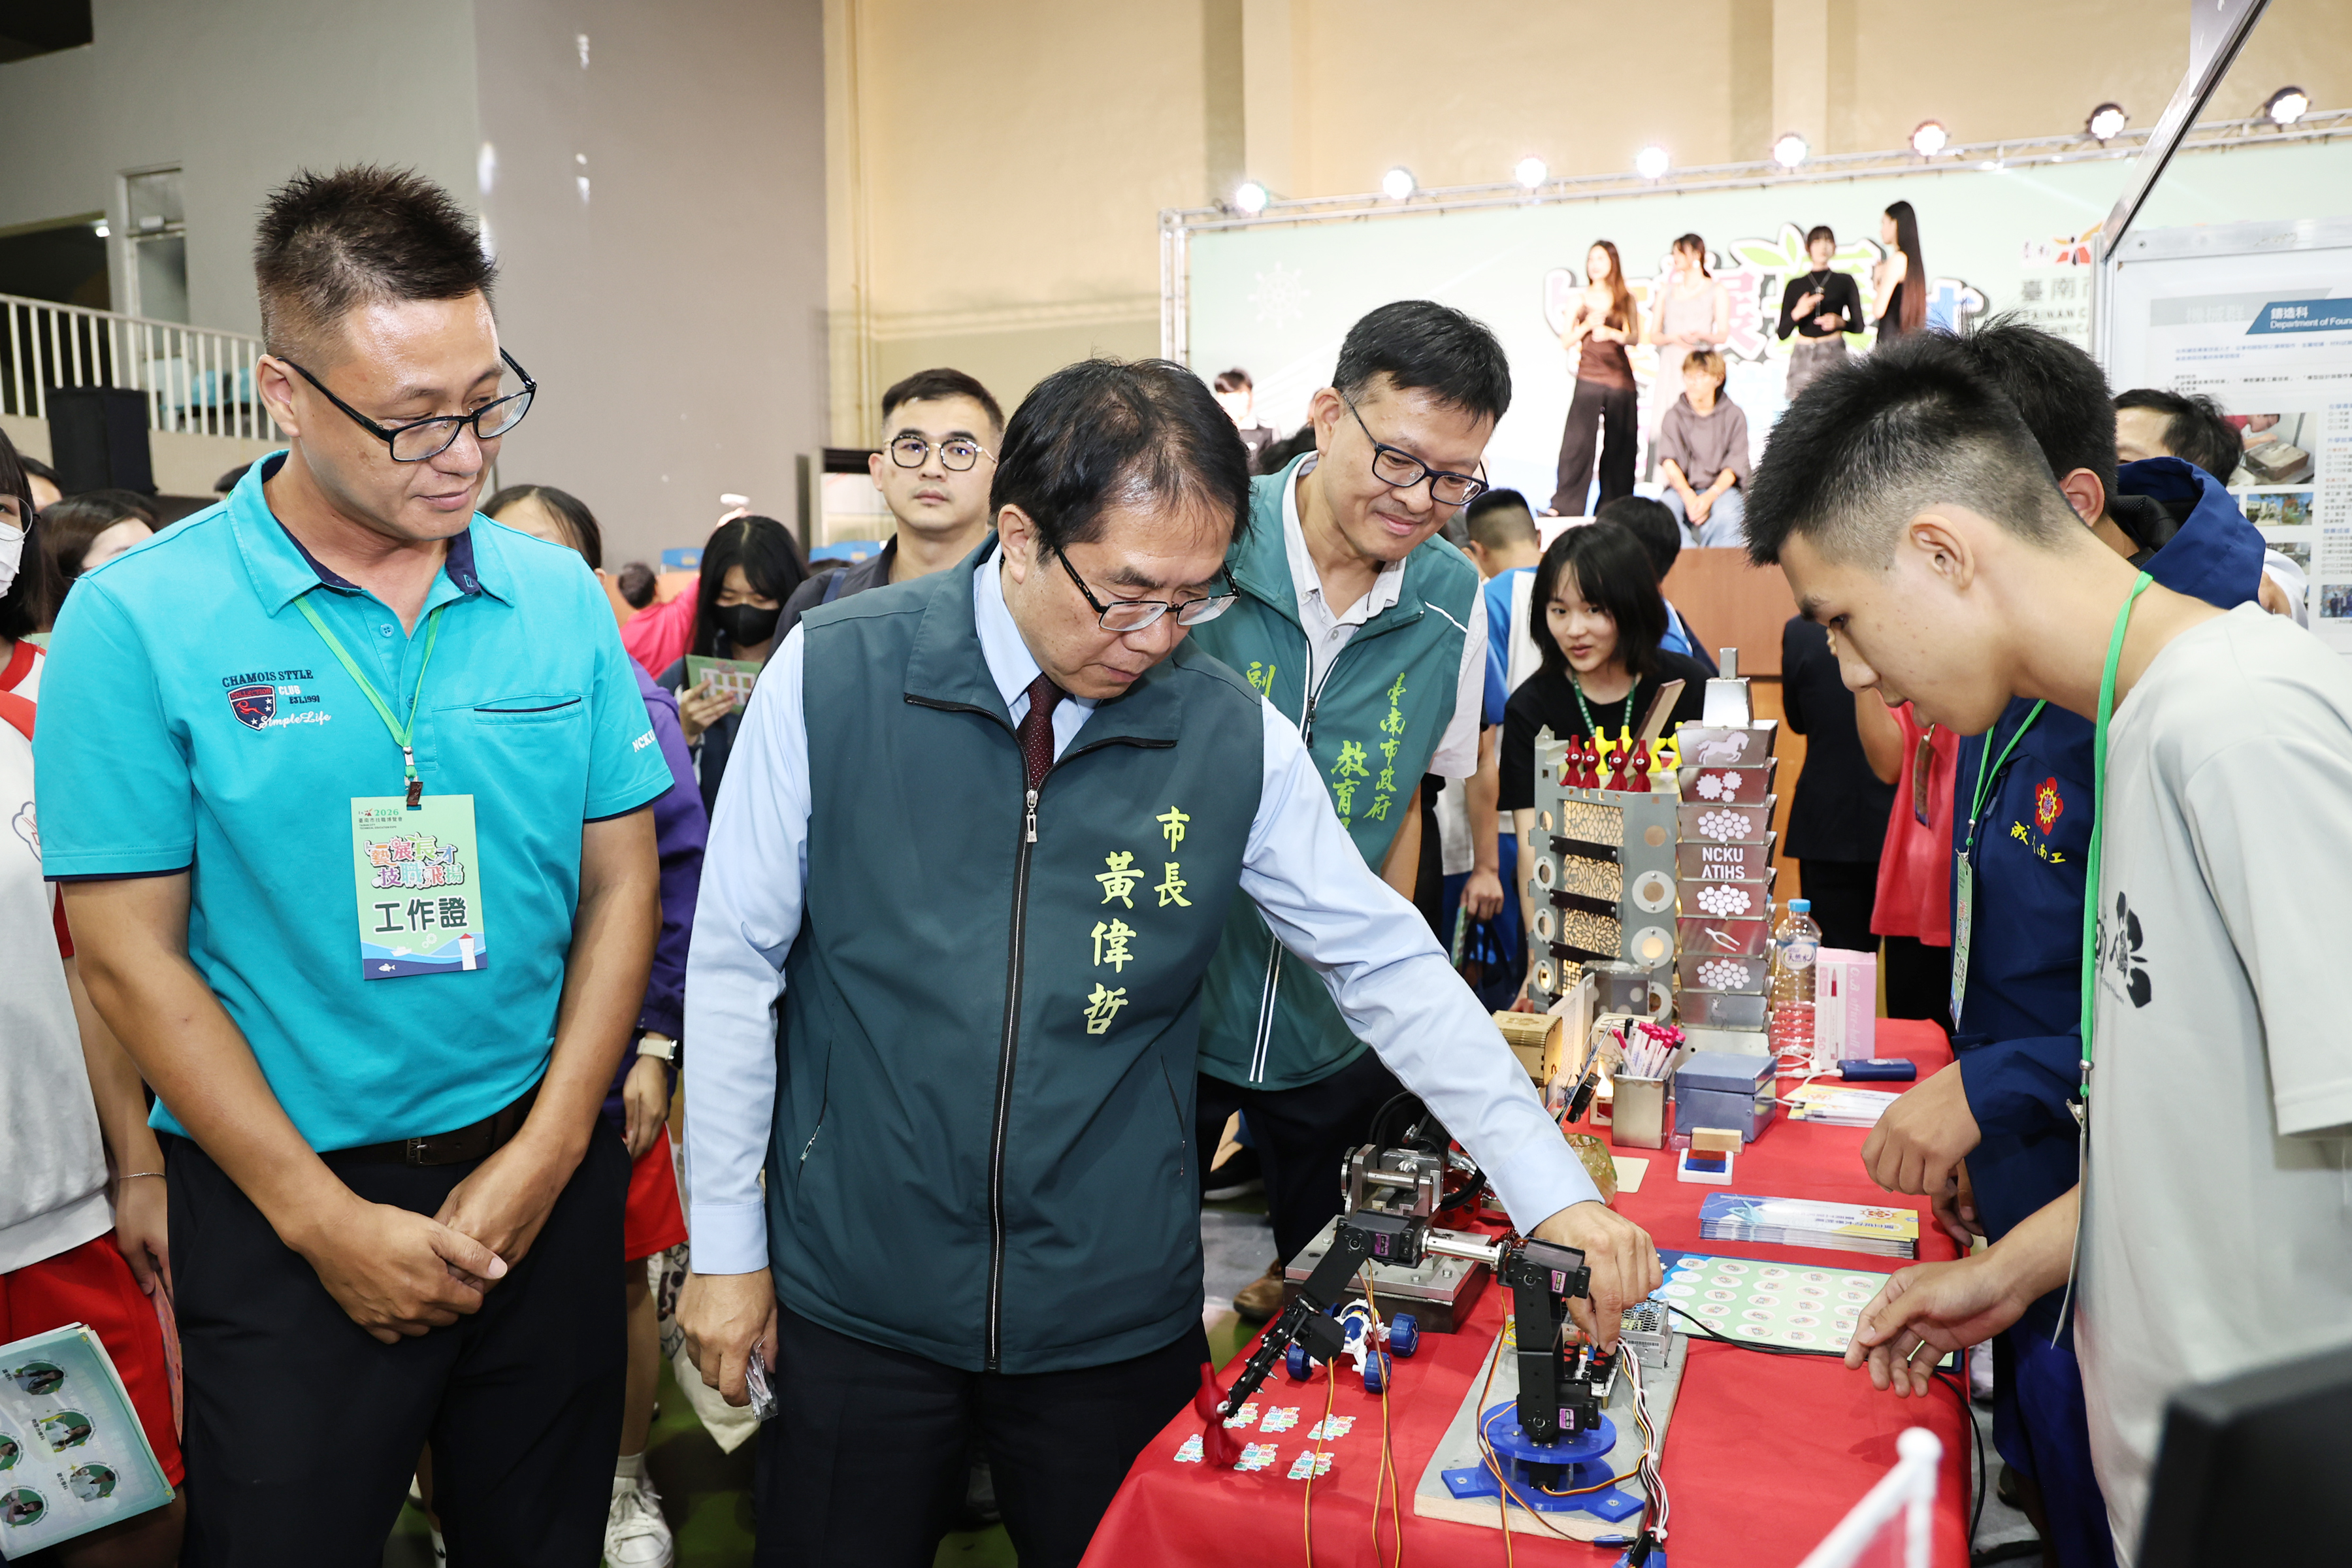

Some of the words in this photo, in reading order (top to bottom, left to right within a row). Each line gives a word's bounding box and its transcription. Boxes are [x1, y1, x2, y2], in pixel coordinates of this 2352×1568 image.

[2270, 306, 2308, 320] 鑄造科
[2270, 319, 2319, 329] Department
[2319, 318, 2329, 327] of
[222, 672, 276, 687] CHAMOIS
[278, 670, 314, 681] STYLE
[231, 687, 272, 699] COLLECTION
[278, 685, 301, 695] CLUB
[632, 728, 656, 753] NCKU
[366, 833, 457, 866] 藝展長才
[1154, 805, 1192, 907] 市長
[1702, 847, 1744, 862] NCKU
[375, 861, 466, 887] 技職飛揚
[1701, 864, 1745, 879] ATIHS
[374, 897, 468, 932] 工作證
[1083, 851, 1145, 1035] 黃偉哲
